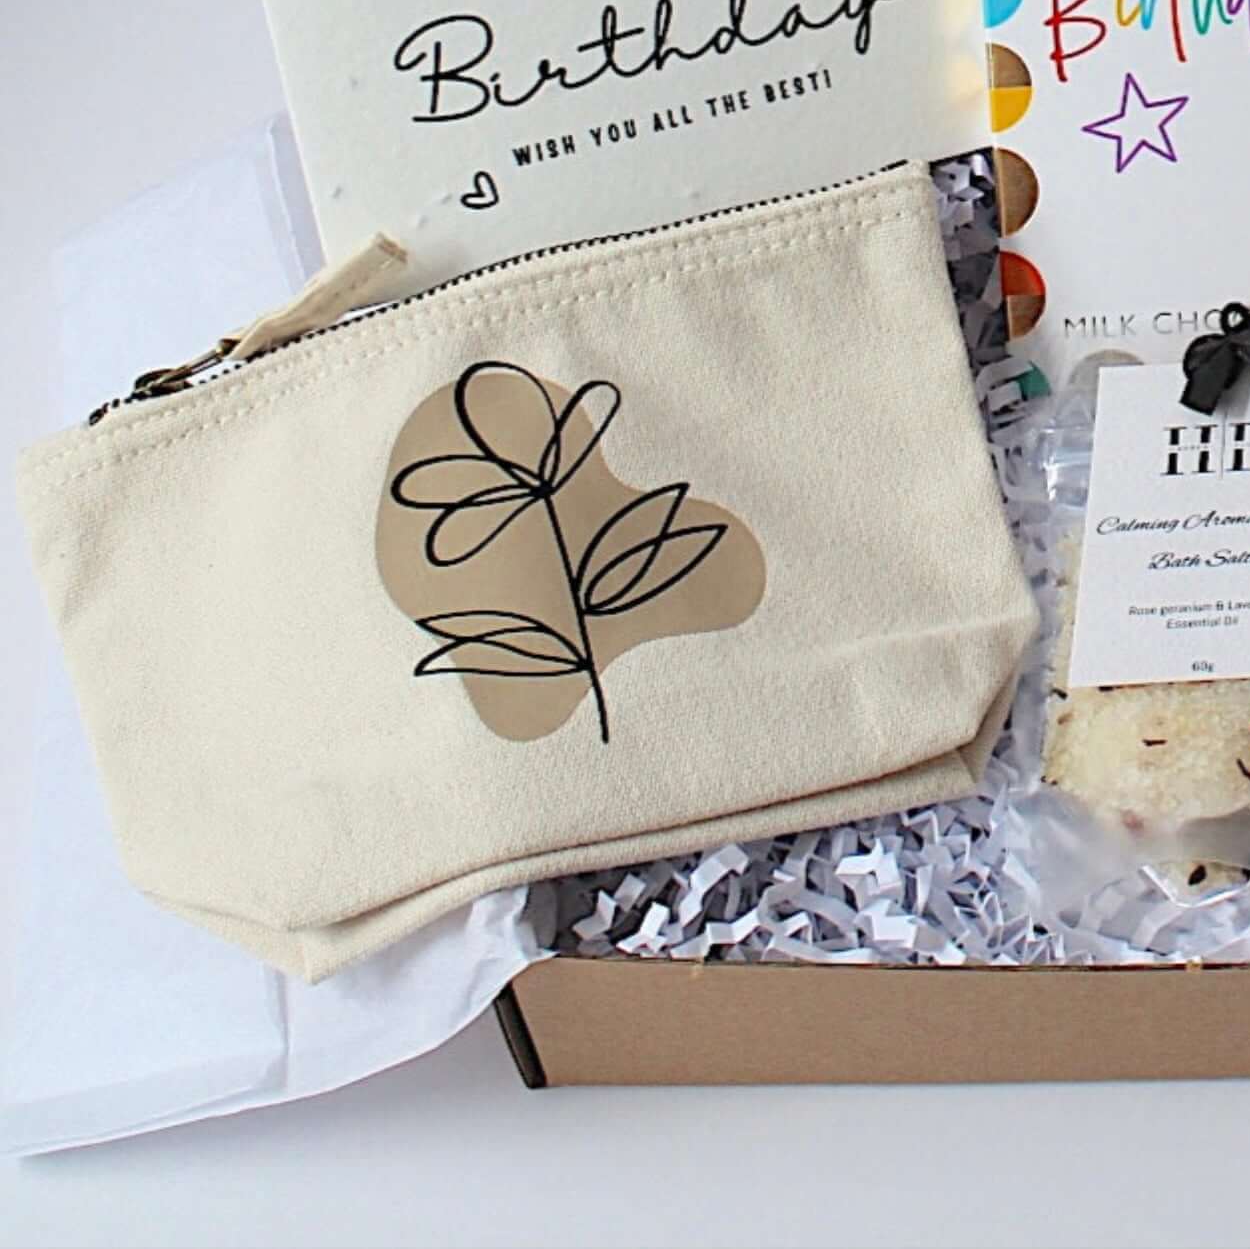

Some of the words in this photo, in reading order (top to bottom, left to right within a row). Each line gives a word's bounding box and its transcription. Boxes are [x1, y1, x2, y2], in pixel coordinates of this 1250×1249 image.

[513, 135, 575, 166] WISH
[590, 119, 638, 147] YOU
[653, 107, 694, 131] ALL
[706, 92, 750, 118] THE
[764, 69, 833, 104] BEST!
[1063, 314, 1136, 339] MILK
[1096, 515, 1180, 535] Calming
[1148, 551, 1200, 570] Bath
[1128, 606, 1156, 616] Rose
